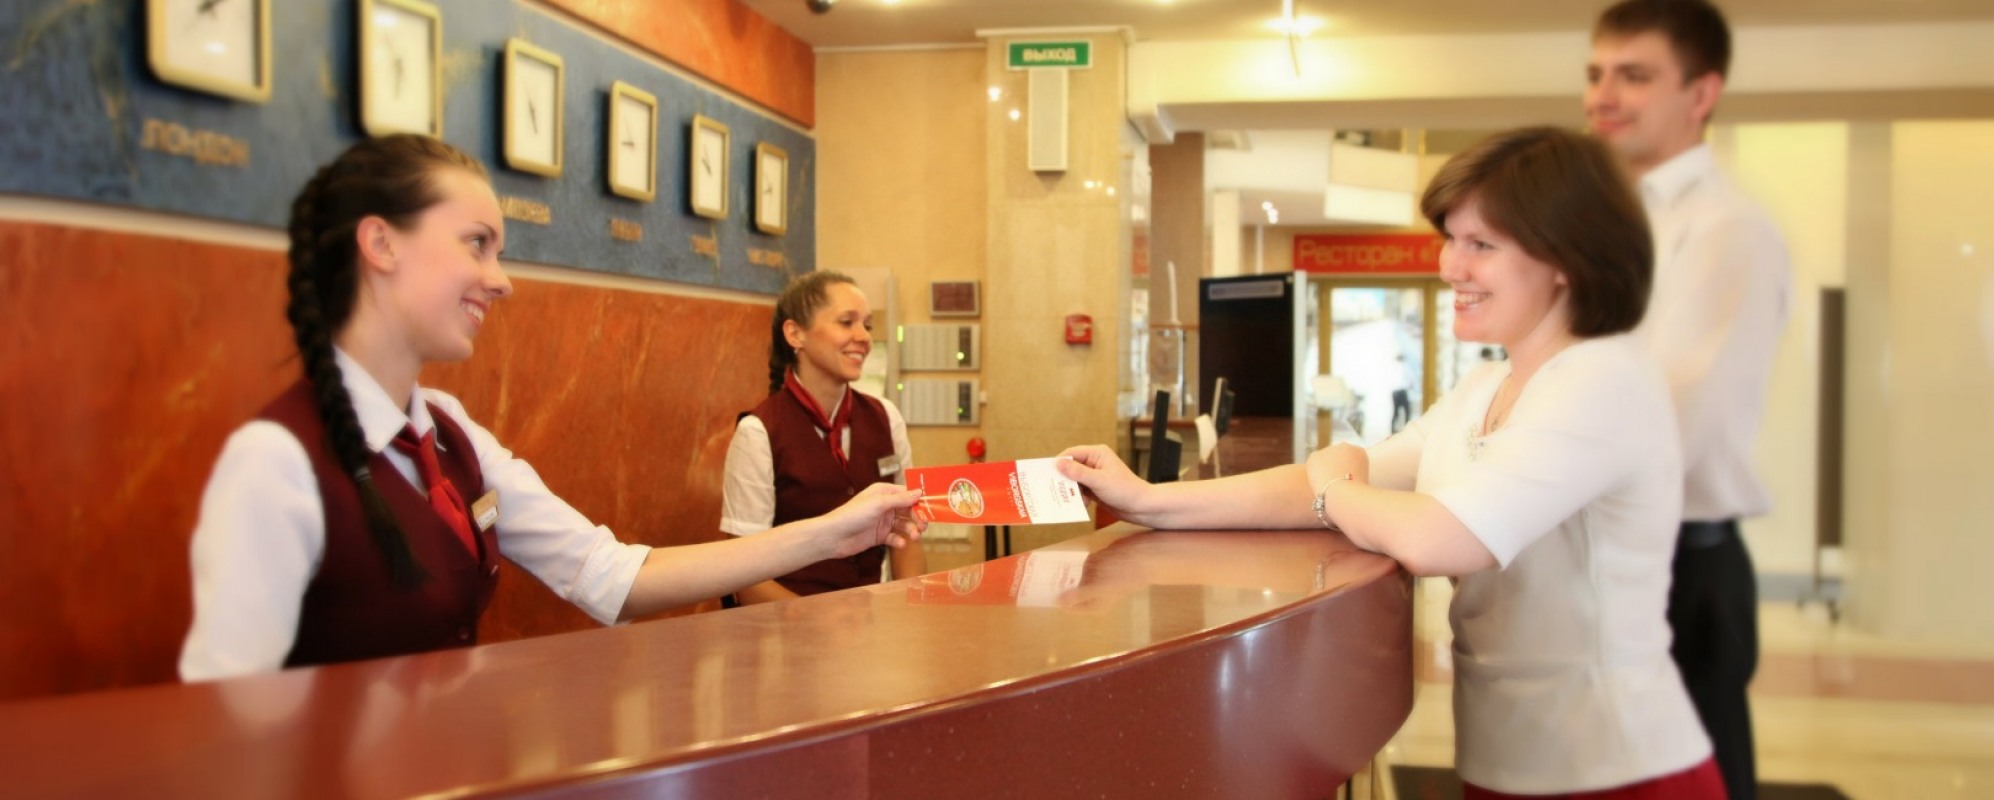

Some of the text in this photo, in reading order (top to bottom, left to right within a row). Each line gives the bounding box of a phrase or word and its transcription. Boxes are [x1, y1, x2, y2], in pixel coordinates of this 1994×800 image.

[1023, 48, 1077, 63] ВЫХОД
[143, 119, 249, 166] ЛОНДОН
[1299, 238, 1414, 270] Ресторан
